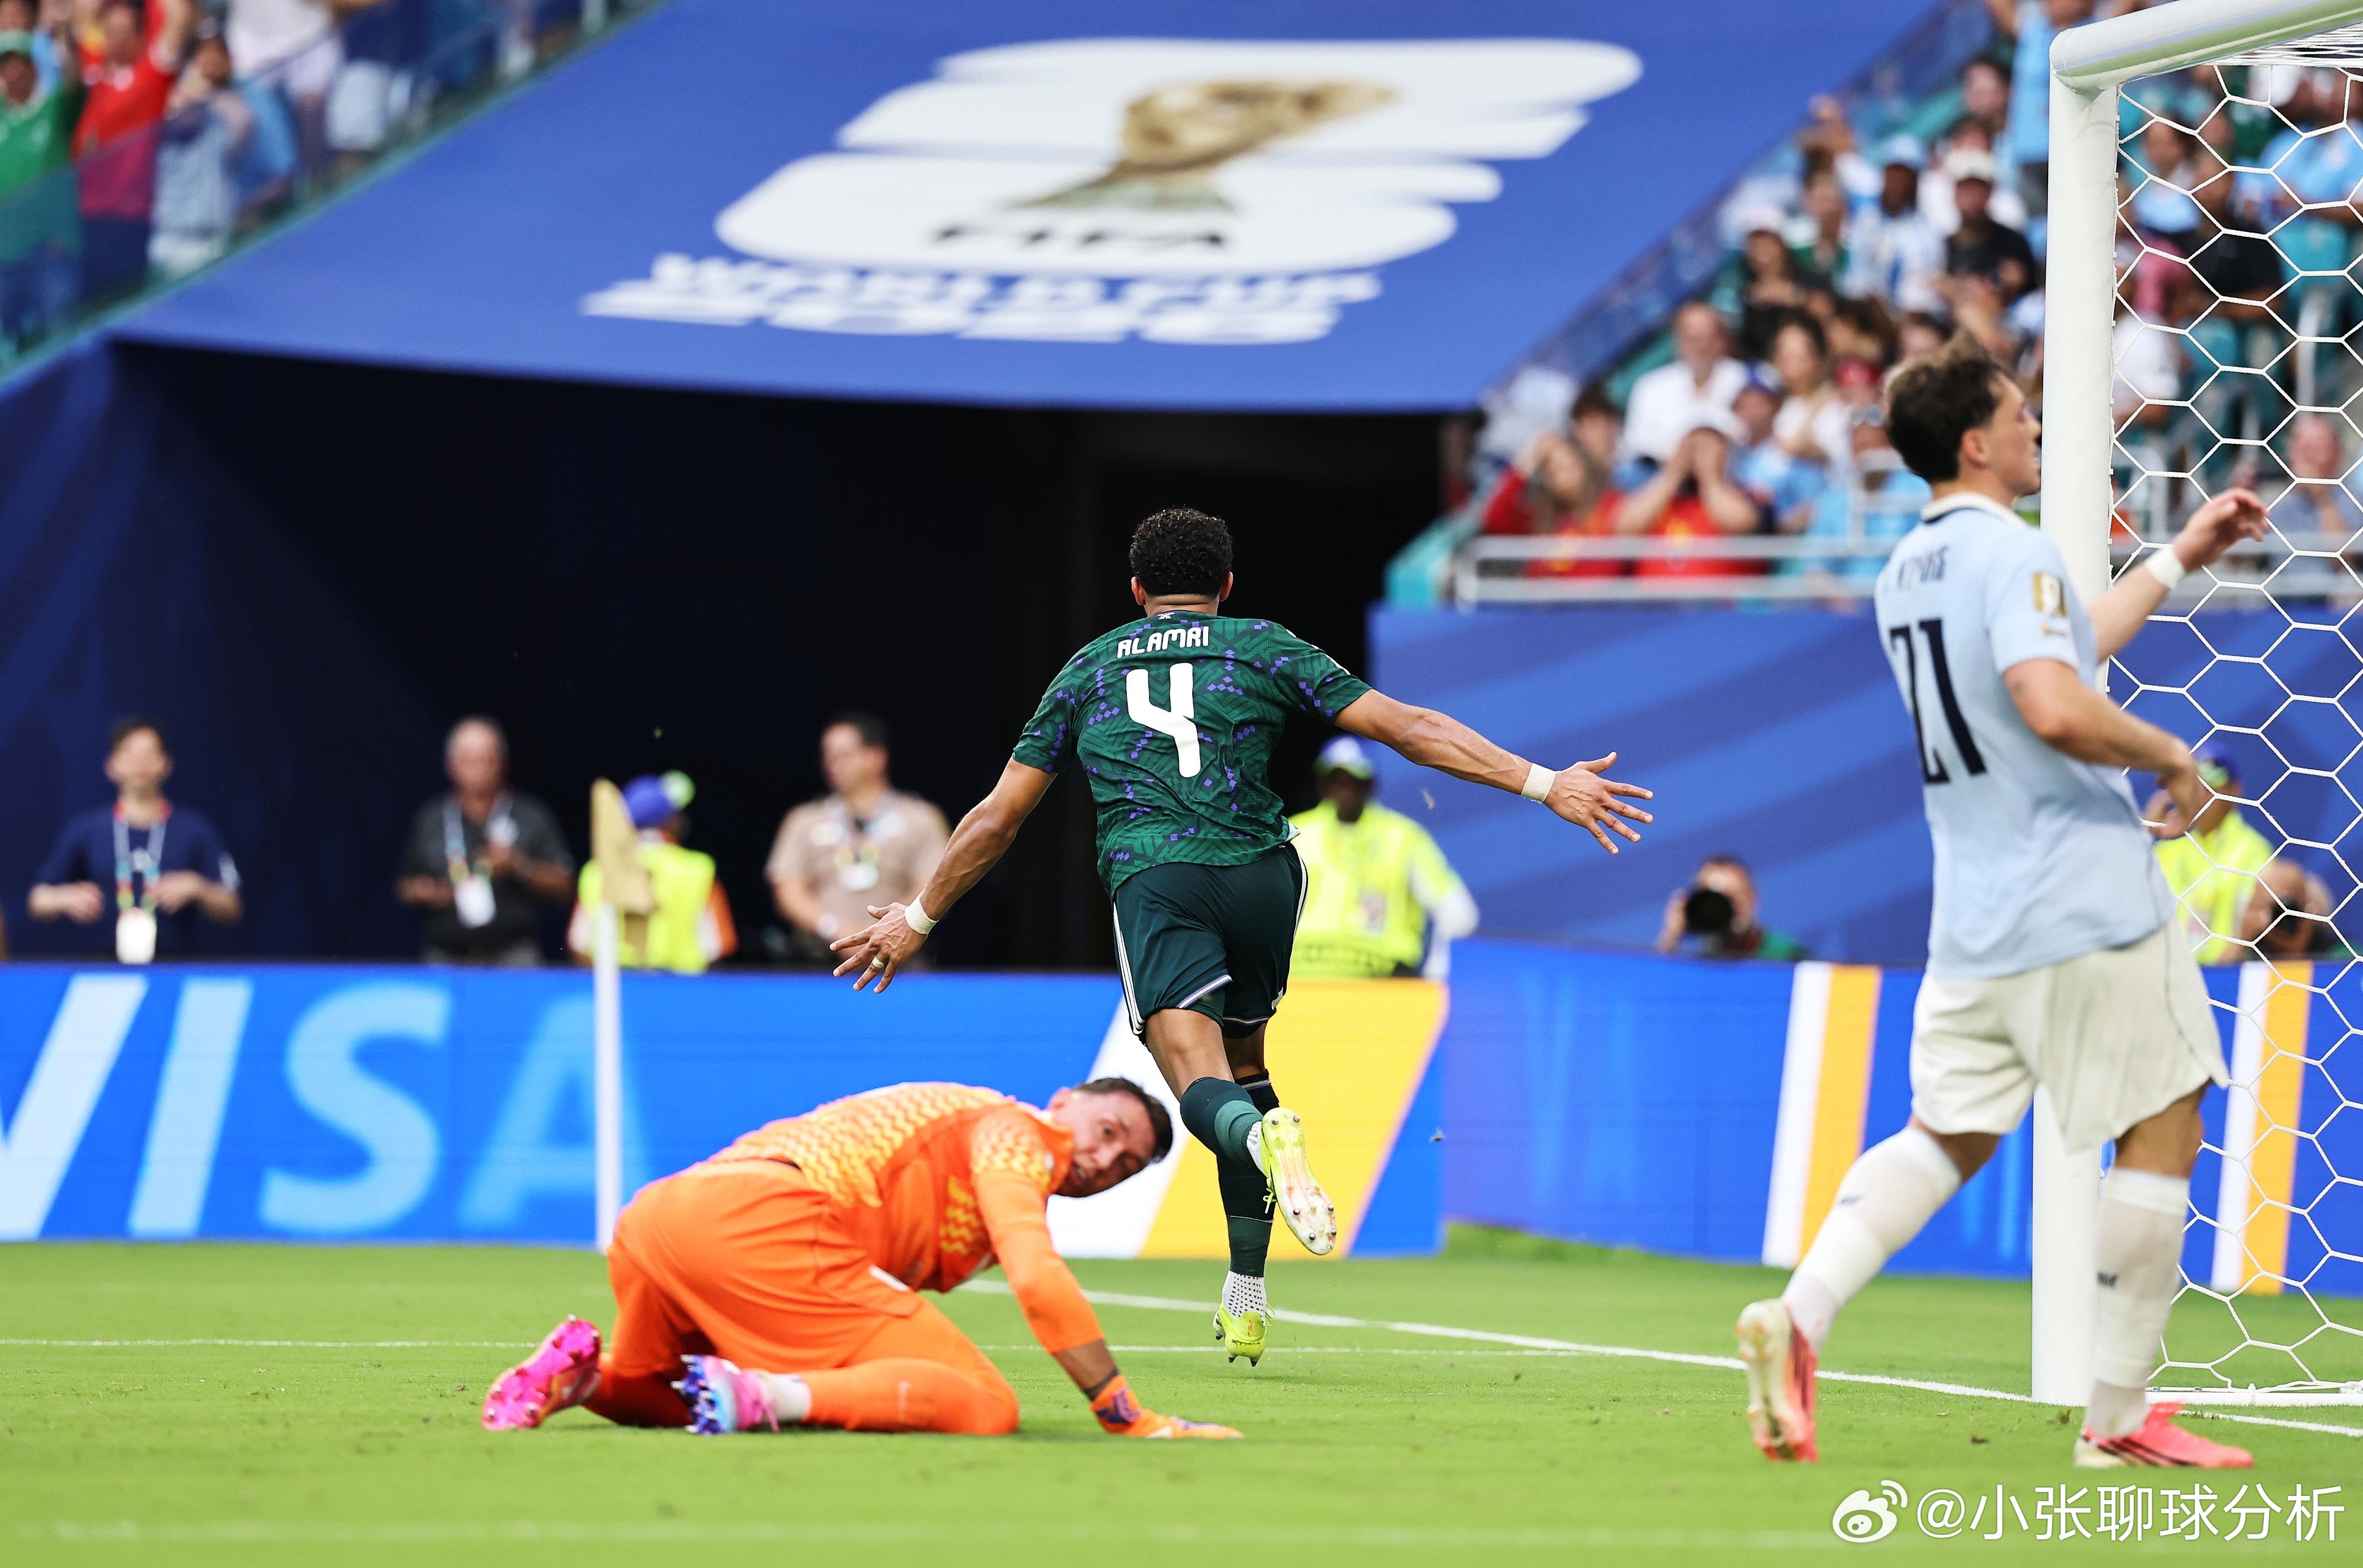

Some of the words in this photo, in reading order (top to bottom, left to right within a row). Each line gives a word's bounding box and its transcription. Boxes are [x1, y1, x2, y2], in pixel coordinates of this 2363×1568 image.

[1117, 626, 1209, 658] ALAMRI
[1890, 617, 1987, 783] 21
[1126, 662, 1201, 778] 4
[0, 974, 662, 1237] VISA
